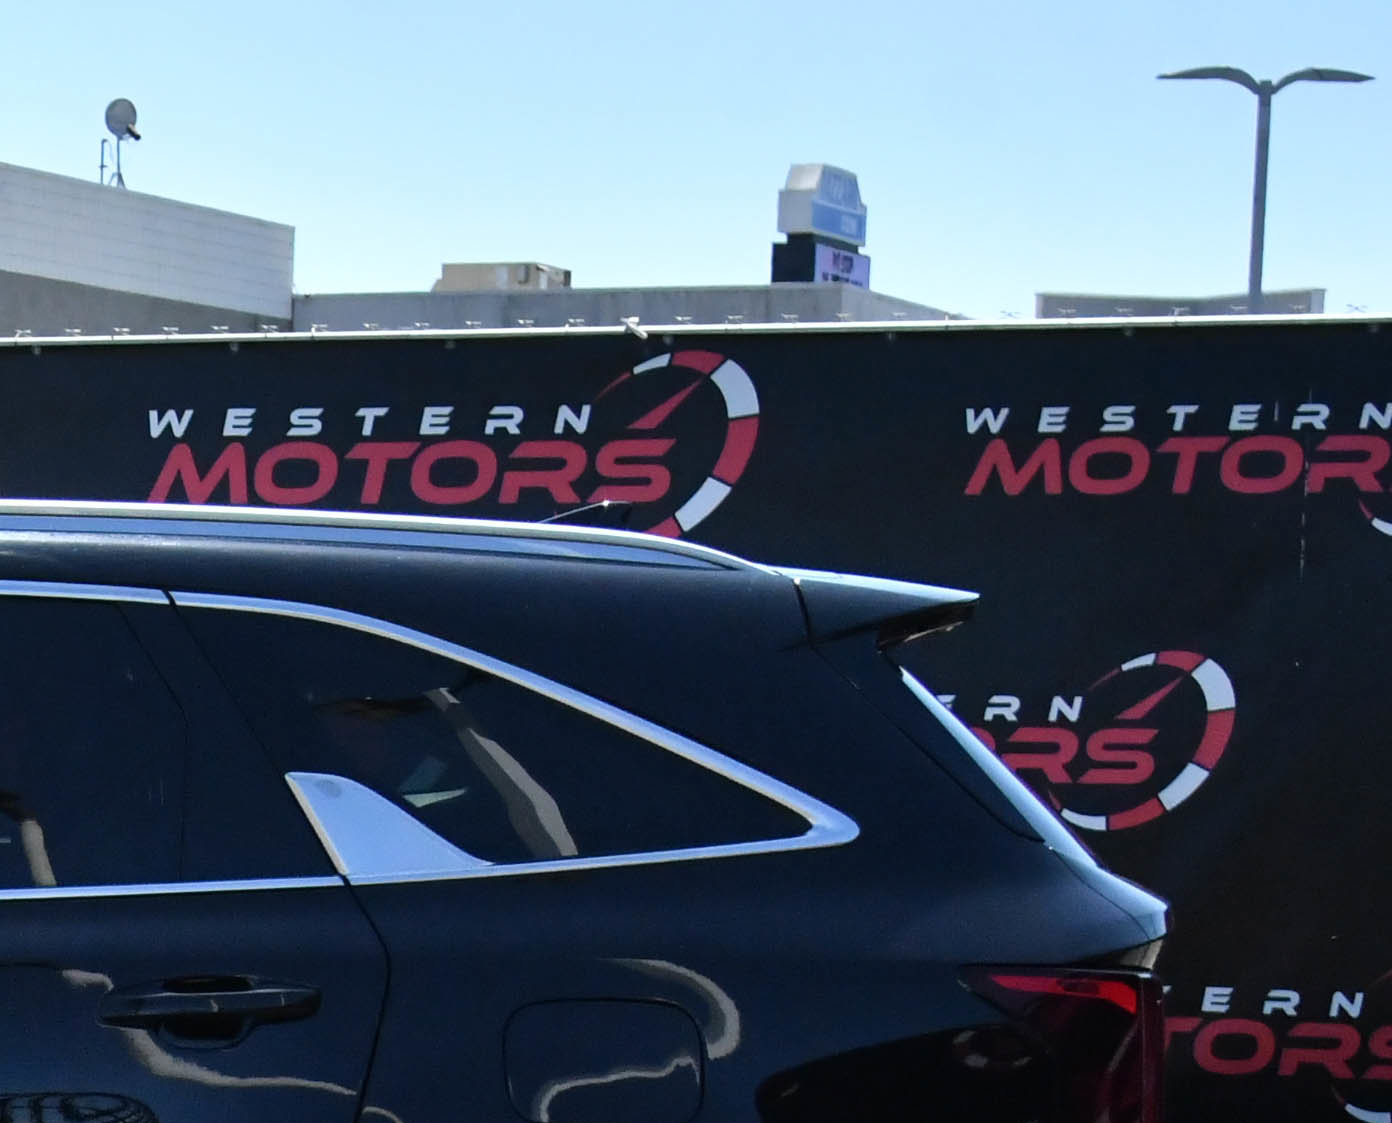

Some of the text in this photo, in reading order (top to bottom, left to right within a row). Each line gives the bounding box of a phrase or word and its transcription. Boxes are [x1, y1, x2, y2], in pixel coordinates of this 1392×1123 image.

[148, 404, 591, 438] WESTERN
[966, 402, 1392, 434] WESTERN
[146, 438, 676, 505] MOTORS
[964, 434, 1392, 495] MOTOR
